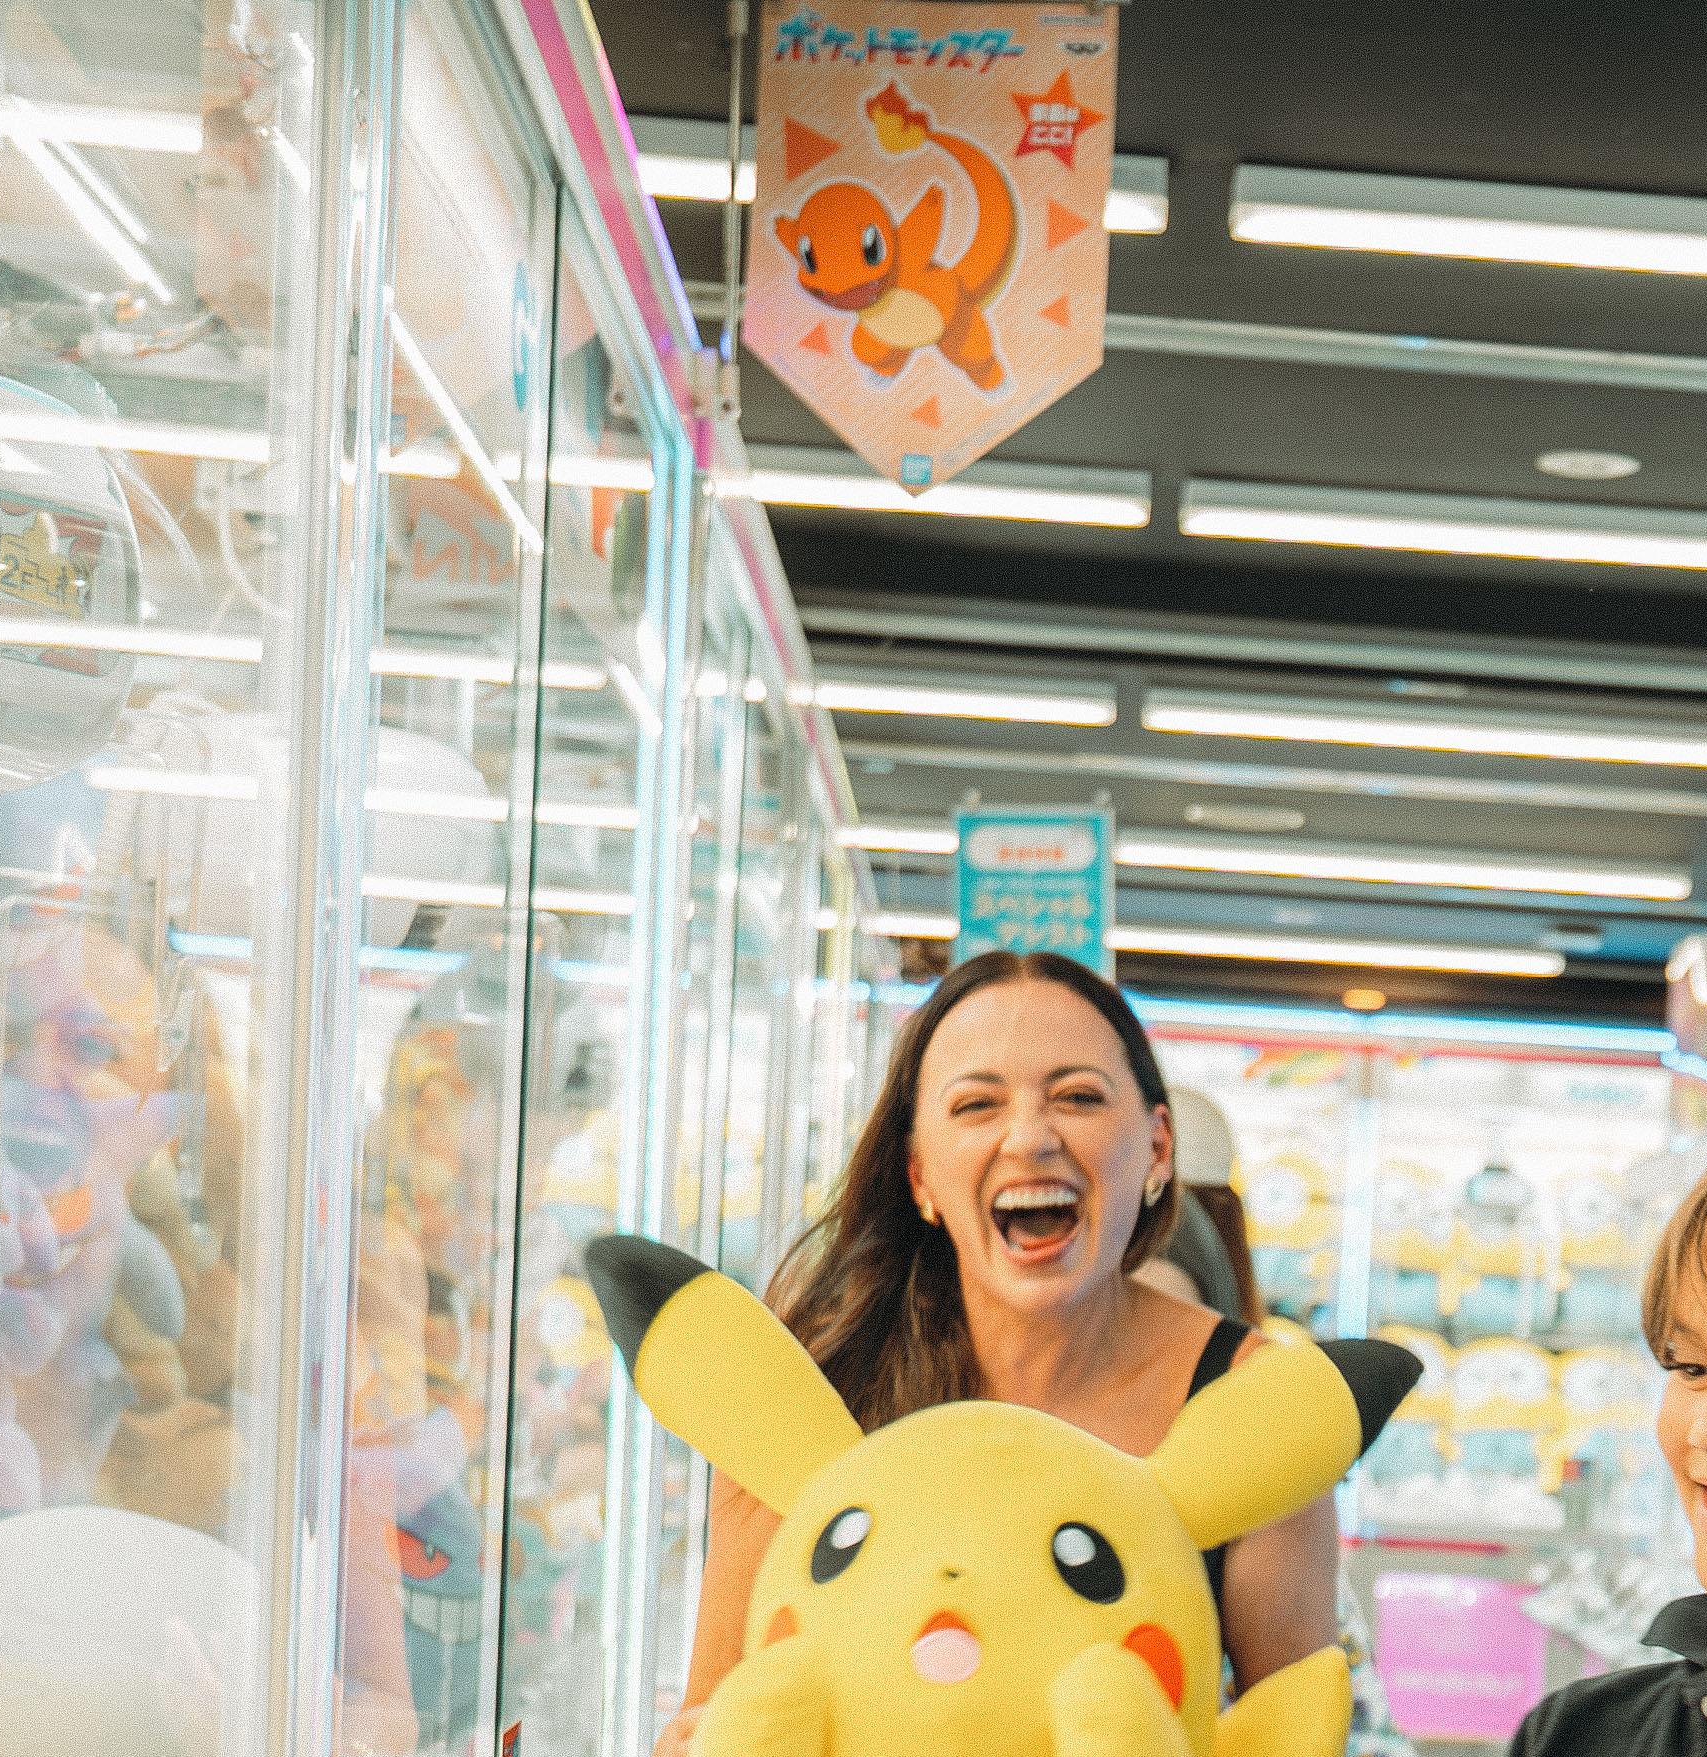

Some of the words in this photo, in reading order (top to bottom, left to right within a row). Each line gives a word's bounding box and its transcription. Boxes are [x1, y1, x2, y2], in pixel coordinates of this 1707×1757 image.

[774, 7, 1026, 74] ポケットモンスター
